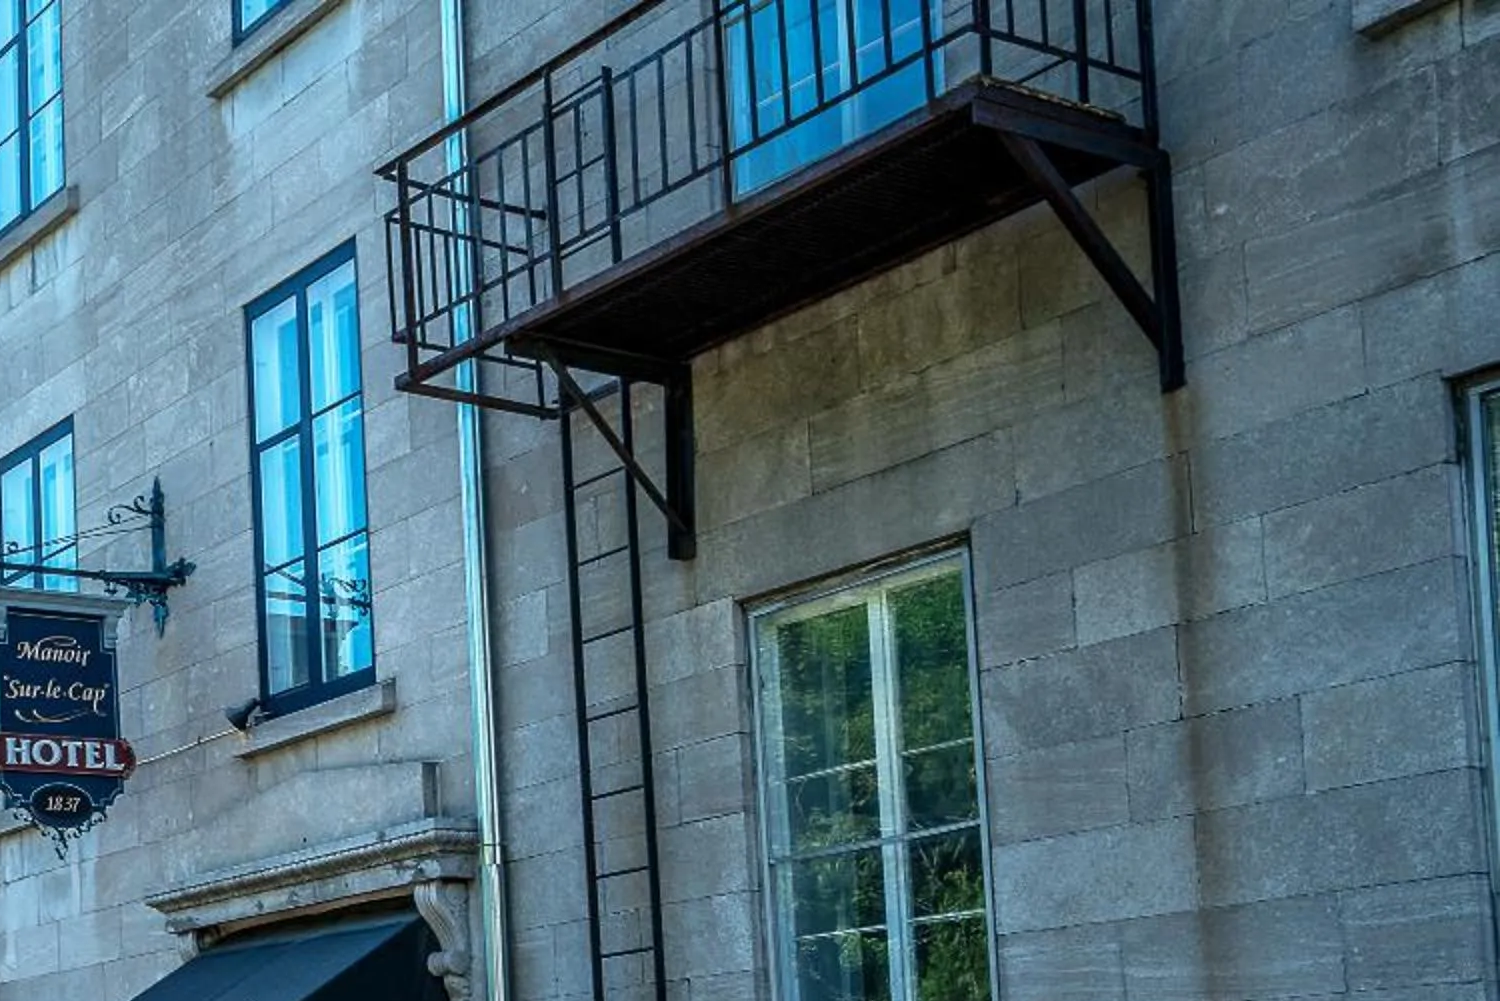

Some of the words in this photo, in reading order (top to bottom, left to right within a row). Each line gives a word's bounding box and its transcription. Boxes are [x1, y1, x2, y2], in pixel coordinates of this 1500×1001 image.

[16, 635, 91, 667] Manoir
[5, 738, 125, 770] HOTEL
[45, 796, 81, 813] 1837
